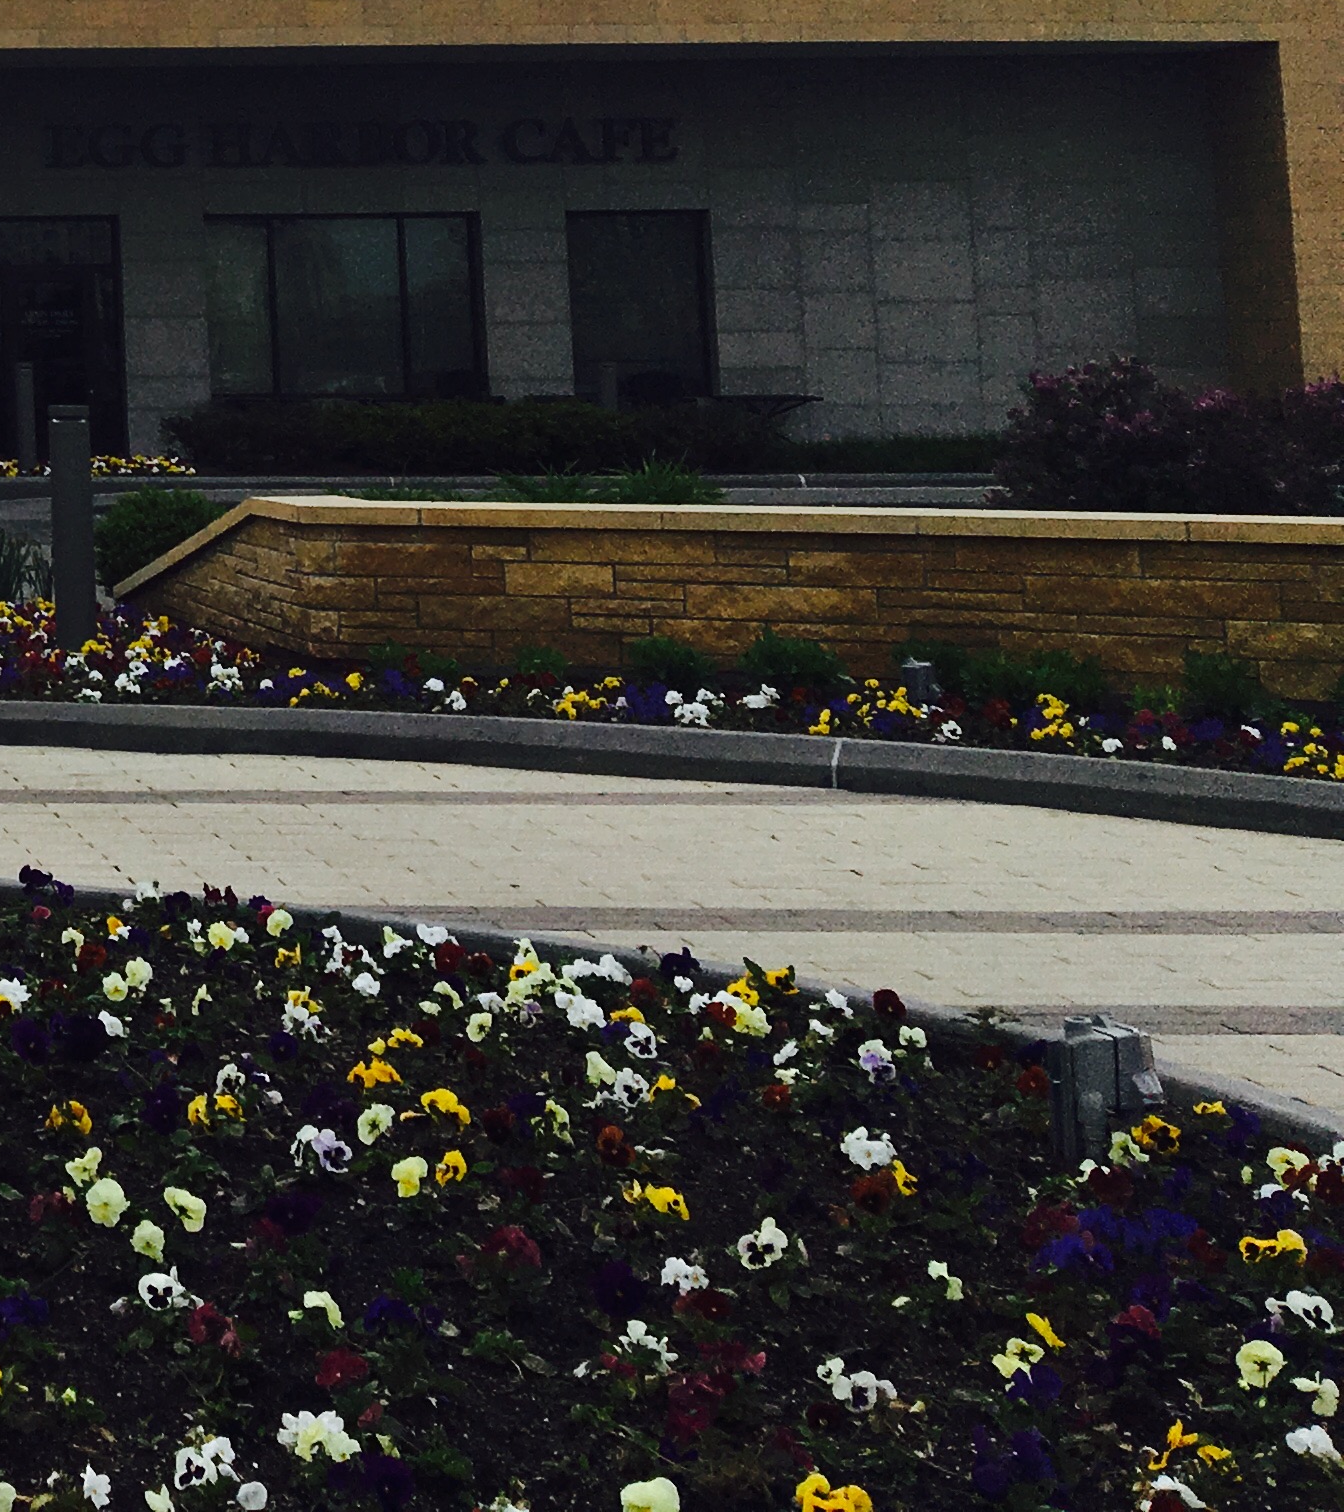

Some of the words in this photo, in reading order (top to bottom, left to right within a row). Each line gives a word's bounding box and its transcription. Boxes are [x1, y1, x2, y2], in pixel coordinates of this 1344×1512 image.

[43, 121, 189, 170] EGG
[203, 117, 487, 168] HARBOR
[499, 115, 681, 165] CAFE
